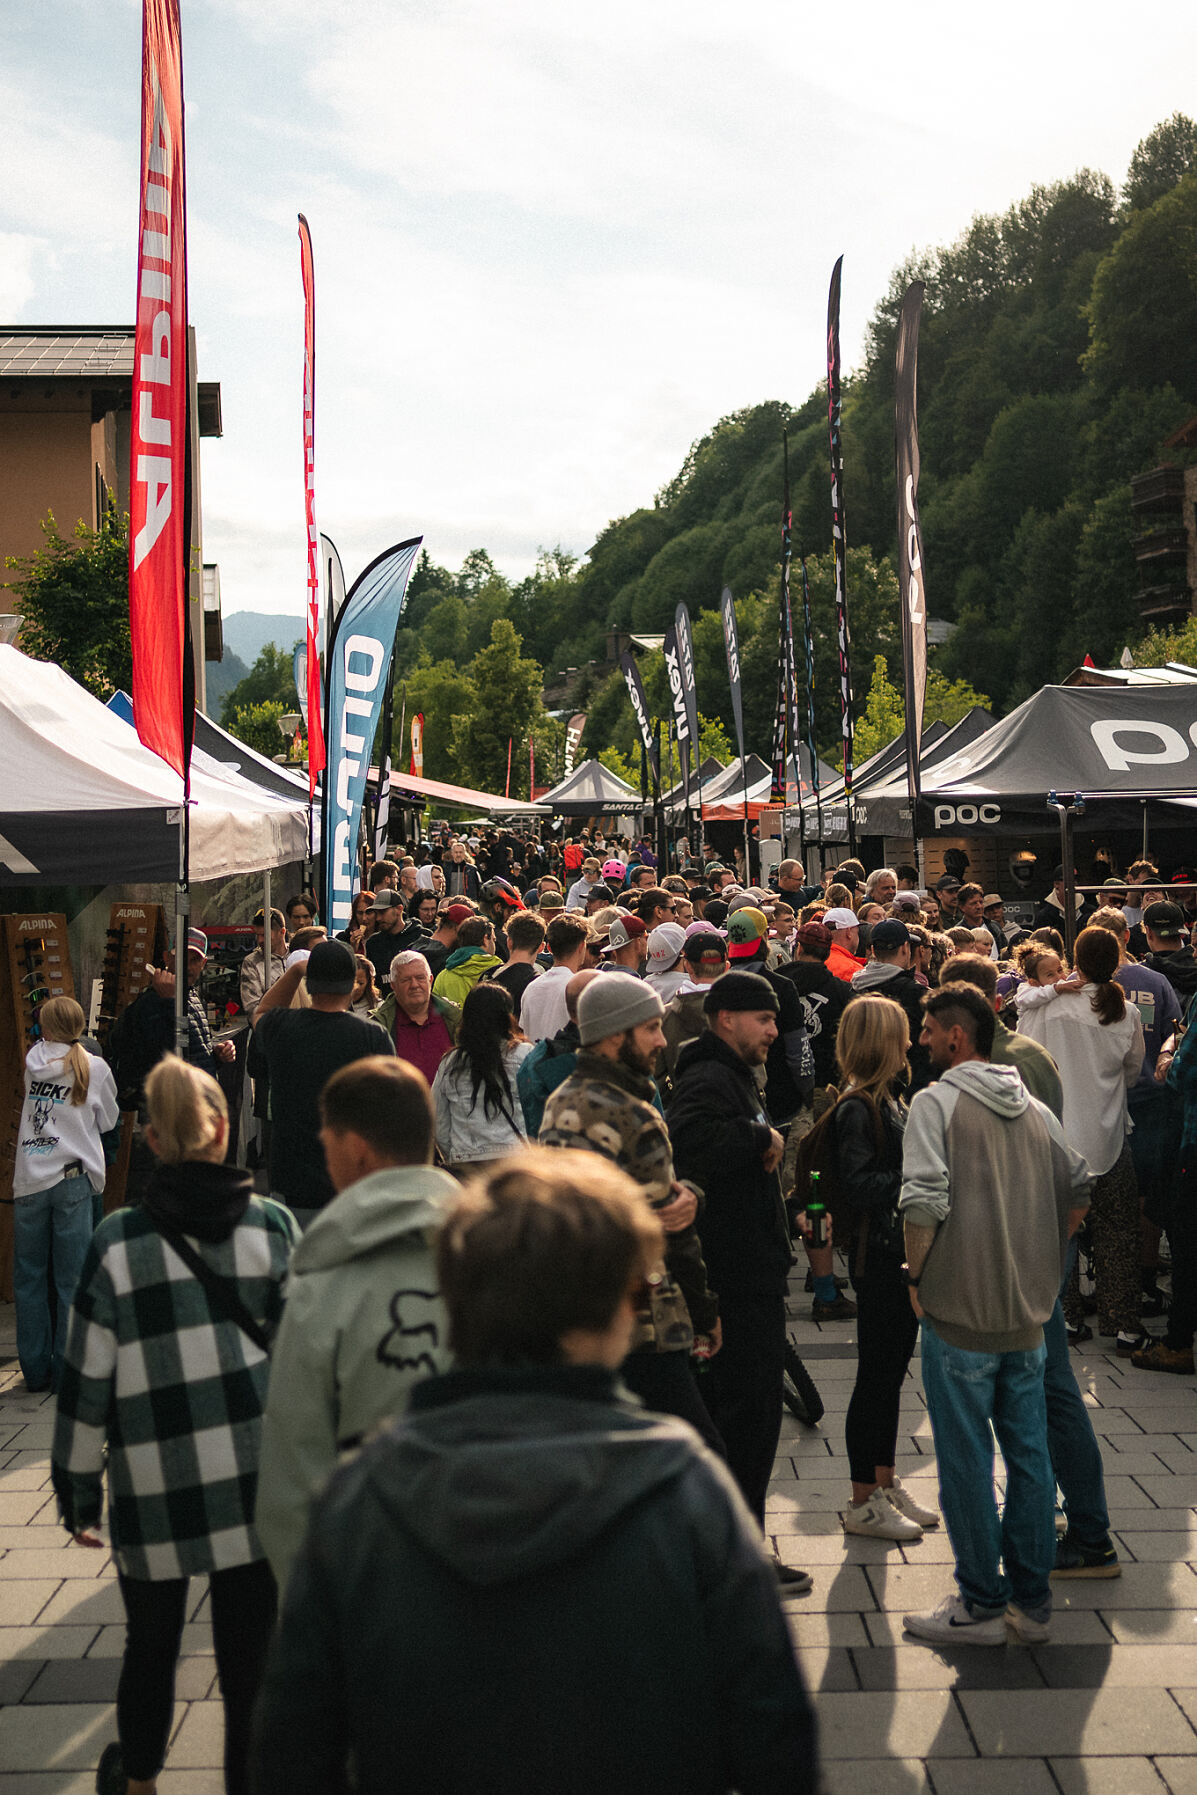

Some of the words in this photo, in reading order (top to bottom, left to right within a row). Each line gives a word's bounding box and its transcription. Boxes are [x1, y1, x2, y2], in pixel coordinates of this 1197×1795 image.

[564, 727, 581, 780] MITH
[602, 803, 634, 811] SANTA
[117, 908, 146, 918] ALPINA
[18, 919, 57, 931] ALPINA
[29, 1081, 71, 1100] SICK!
